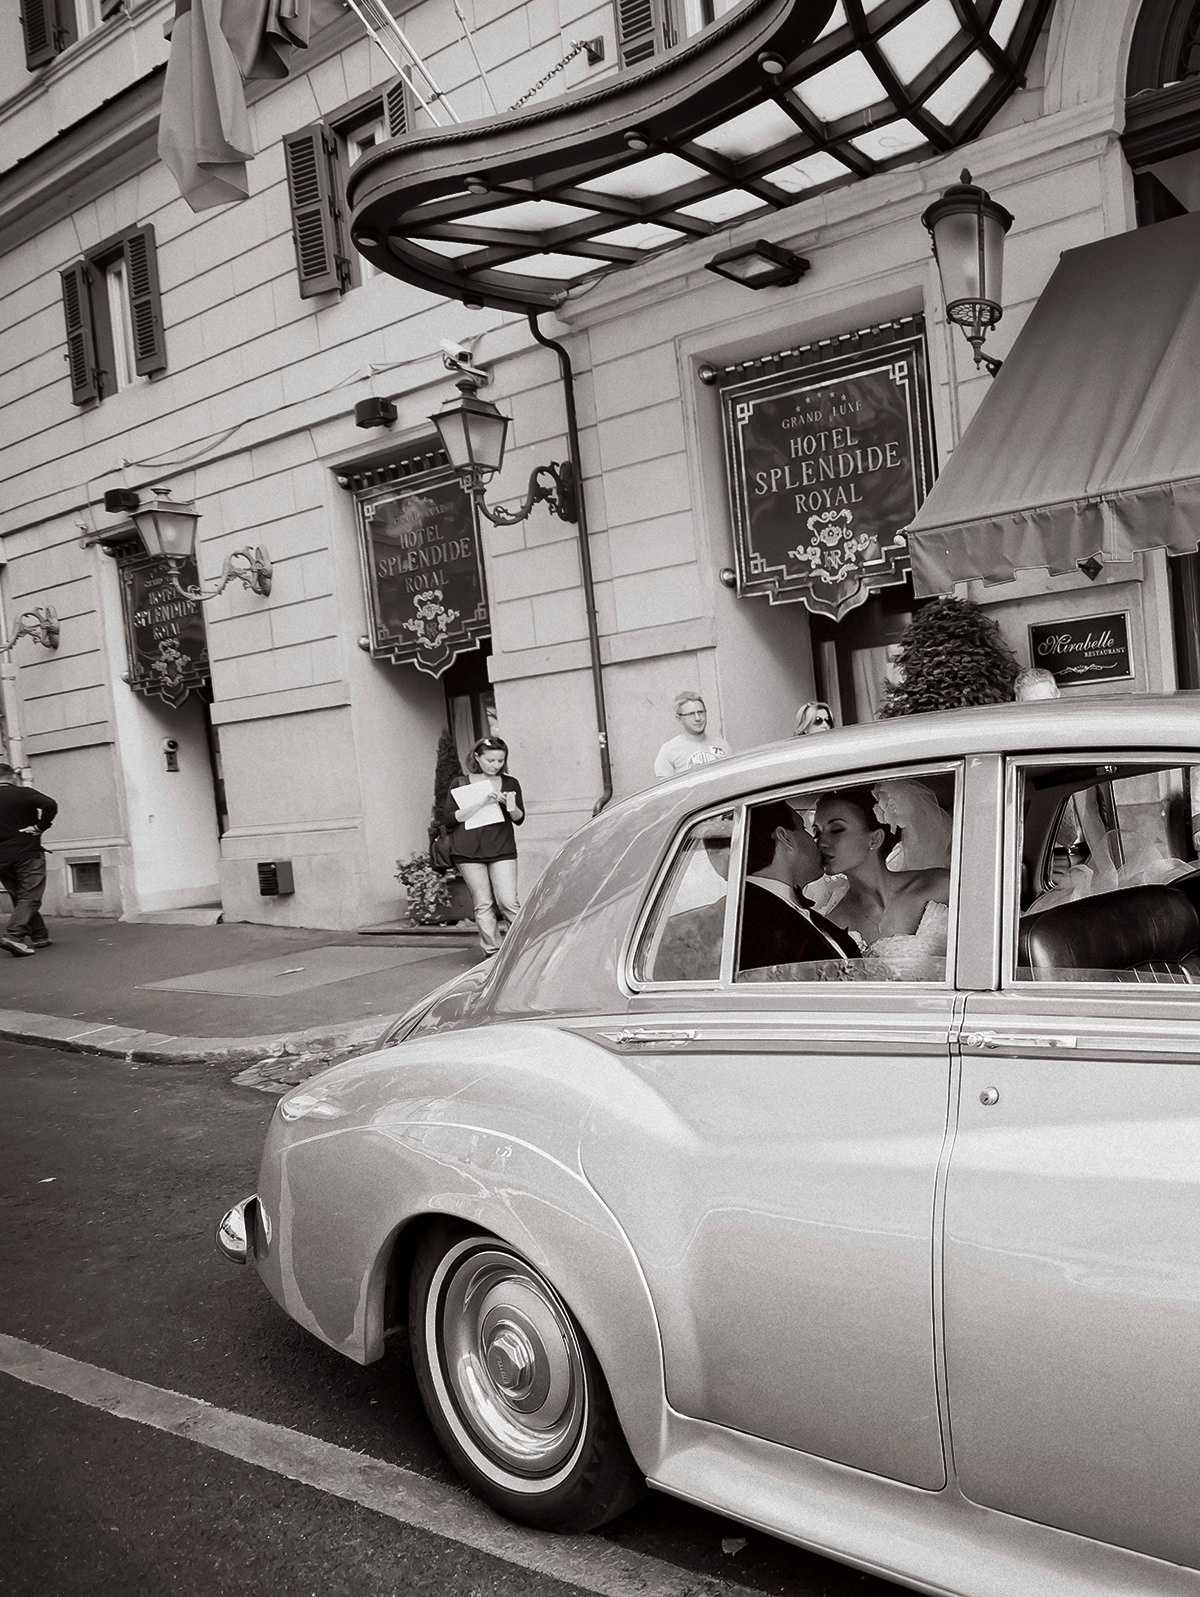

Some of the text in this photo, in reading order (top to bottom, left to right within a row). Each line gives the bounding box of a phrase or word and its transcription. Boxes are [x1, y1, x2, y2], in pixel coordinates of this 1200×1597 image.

[782, 400, 863, 430] GRAND LUXE
[789, 426, 859, 459] HOTEL
[755, 441, 901, 495] SPLENDIDE
[795, 483, 863, 514] ROYAL
[400, 524, 444, 550] HOTEL
[378, 537, 472, 579] SPLENDIDE
[404, 569, 449, 594] ROYAL
[1038, 630, 1114, 656] Mirabelle
[1084, 647, 1126, 658] RESTAURANT
